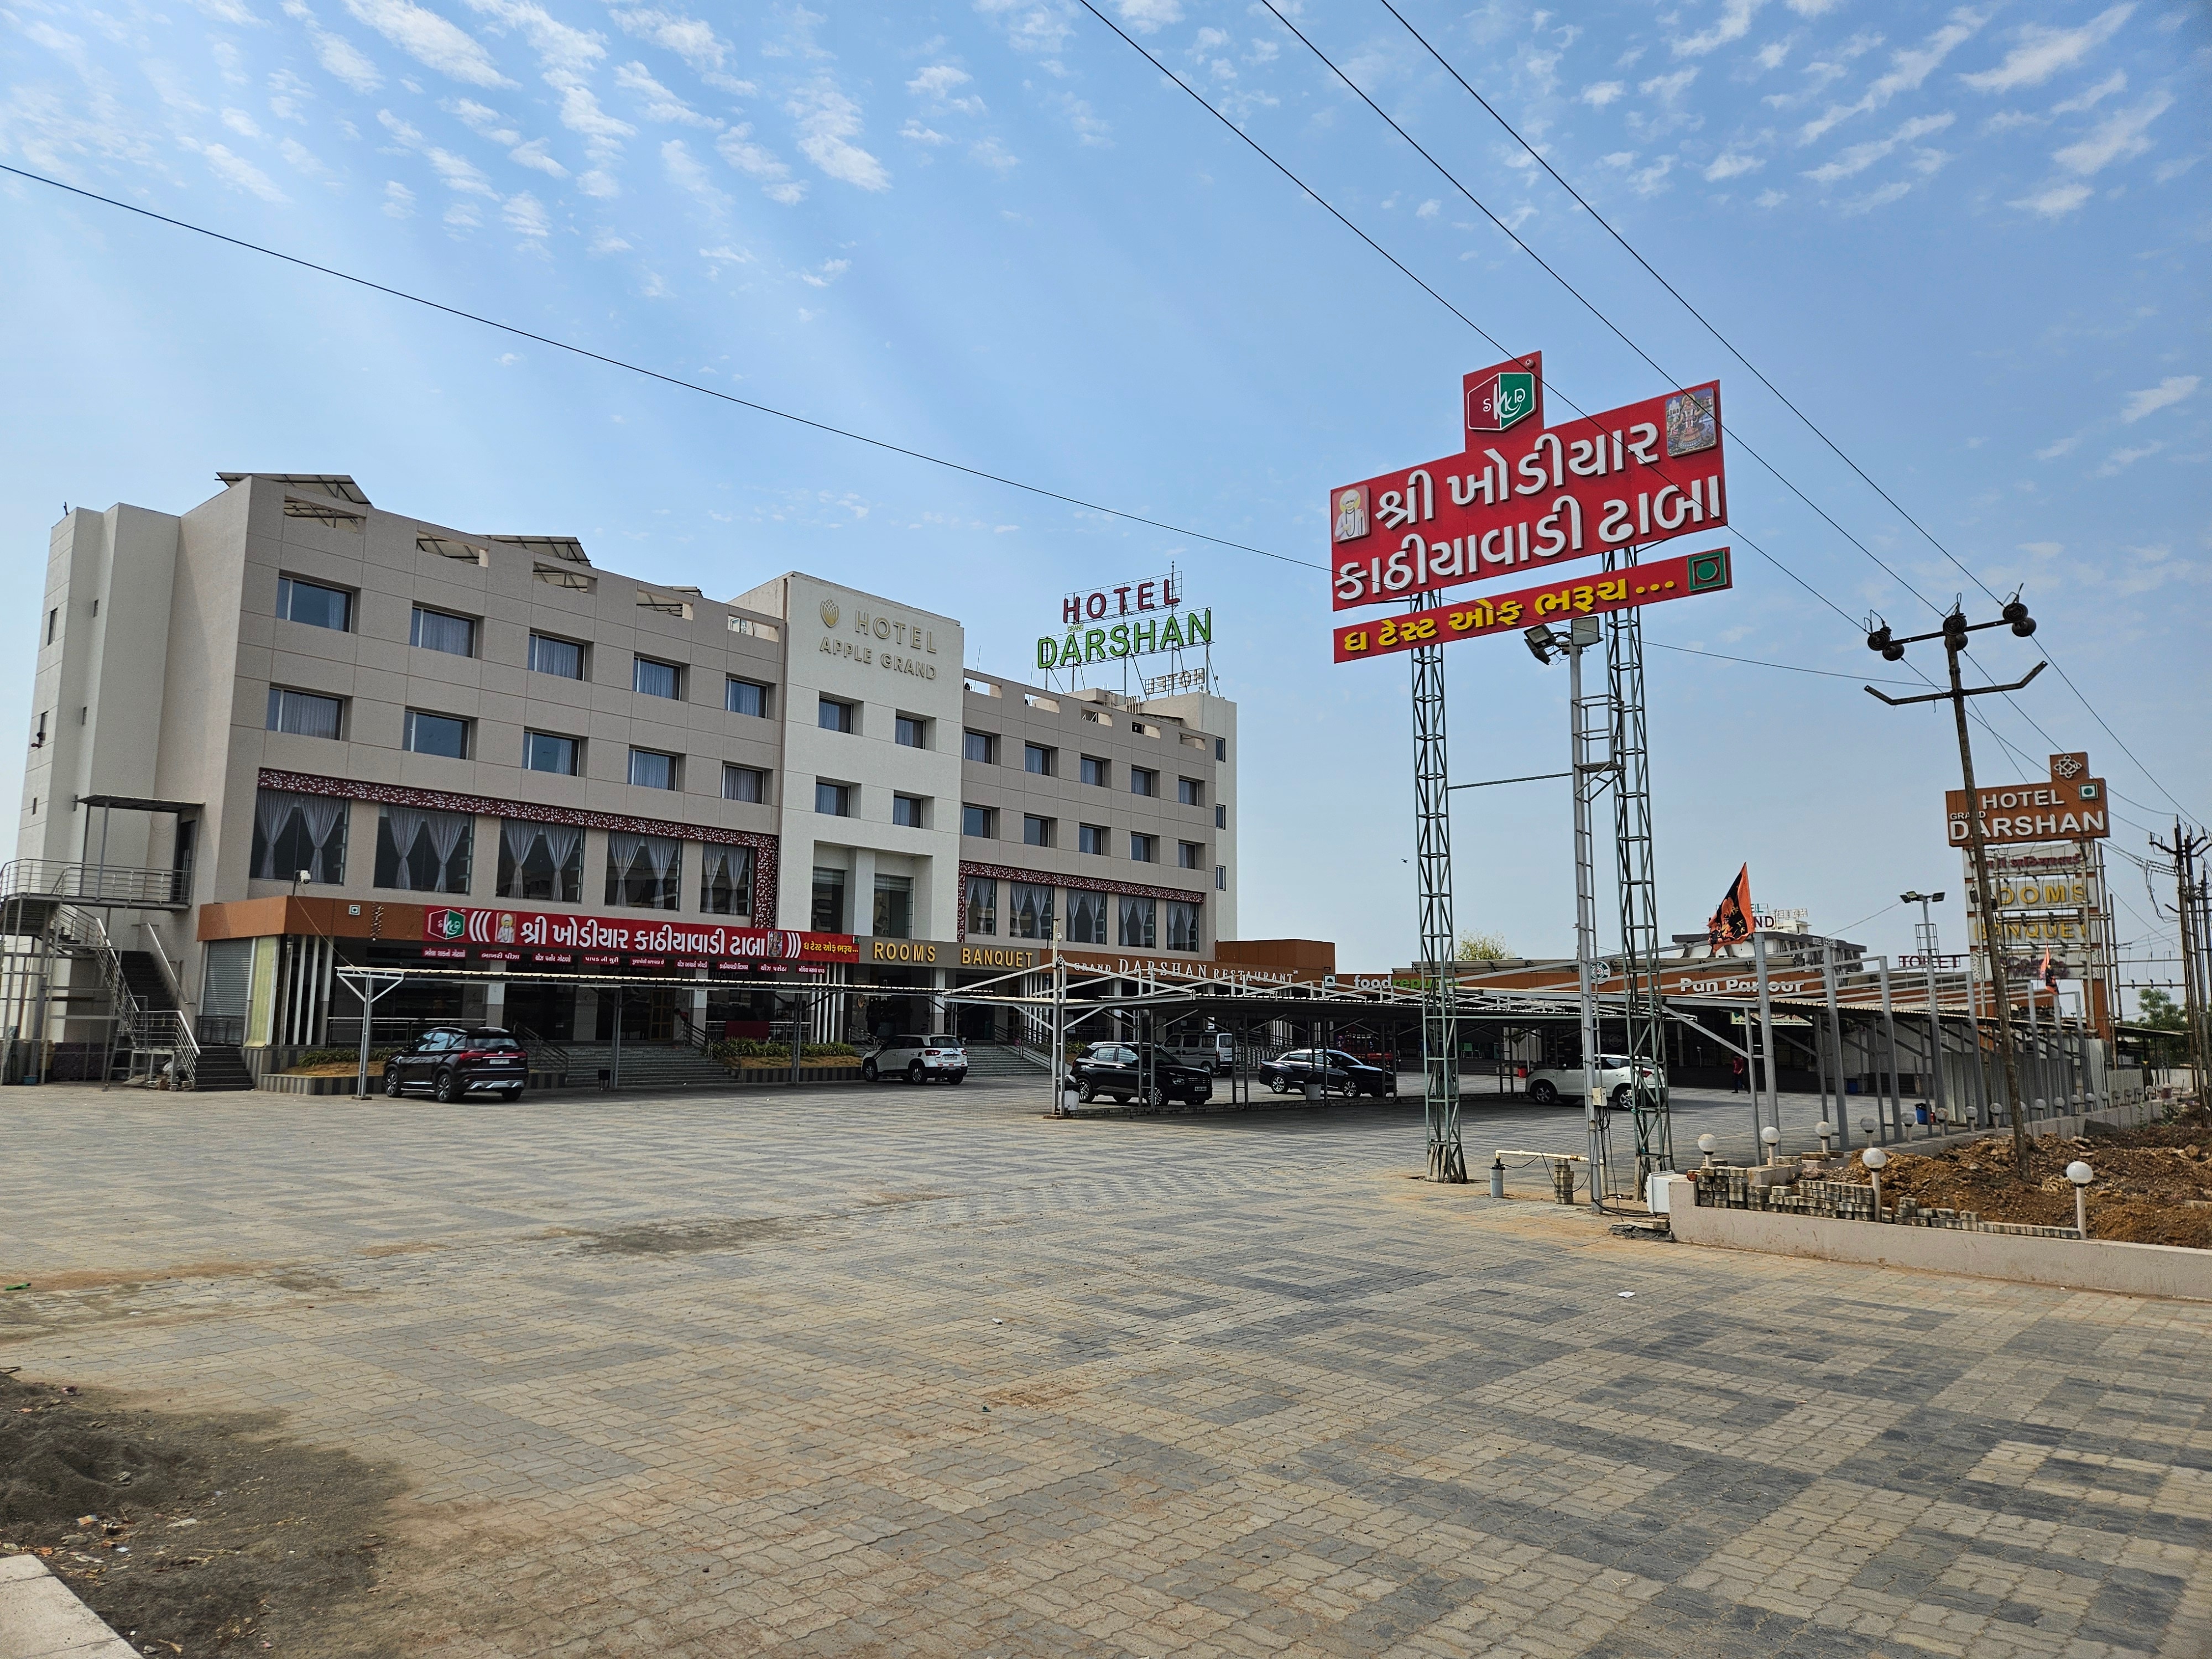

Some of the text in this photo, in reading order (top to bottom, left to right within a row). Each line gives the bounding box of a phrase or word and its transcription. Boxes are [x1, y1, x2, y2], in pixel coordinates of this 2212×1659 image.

[1375, 422, 1659, 529] શ્રી ખોડીયાર
[1334, 475, 1722, 602] કાઠીયાવાડી ઢાબા
[1063, 578, 1180, 624] HOTEL
[855, 609, 937, 654] HOTEL
[1037, 609, 1211, 669] DARSHAN
[1378, 618, 1438, 646] ટેસ્ટ
[820, 637, 937, 680] APPLE GRAND
[1950, 811, 1986, 820] GRAD
[1982, 789, 2065, 810] HOTEL
[1996, 884, 2084, 905] OOMS
[520, 915, 765, 956] શ્રી ખોડીયાર કાઠીયાવાડી ઢાબા
[874, 942, 1033, 968] ROOMS BANQUET
[1118, 958, 1207, 979] DARSHAN
[1680, 978, 1718, 992] Pan
